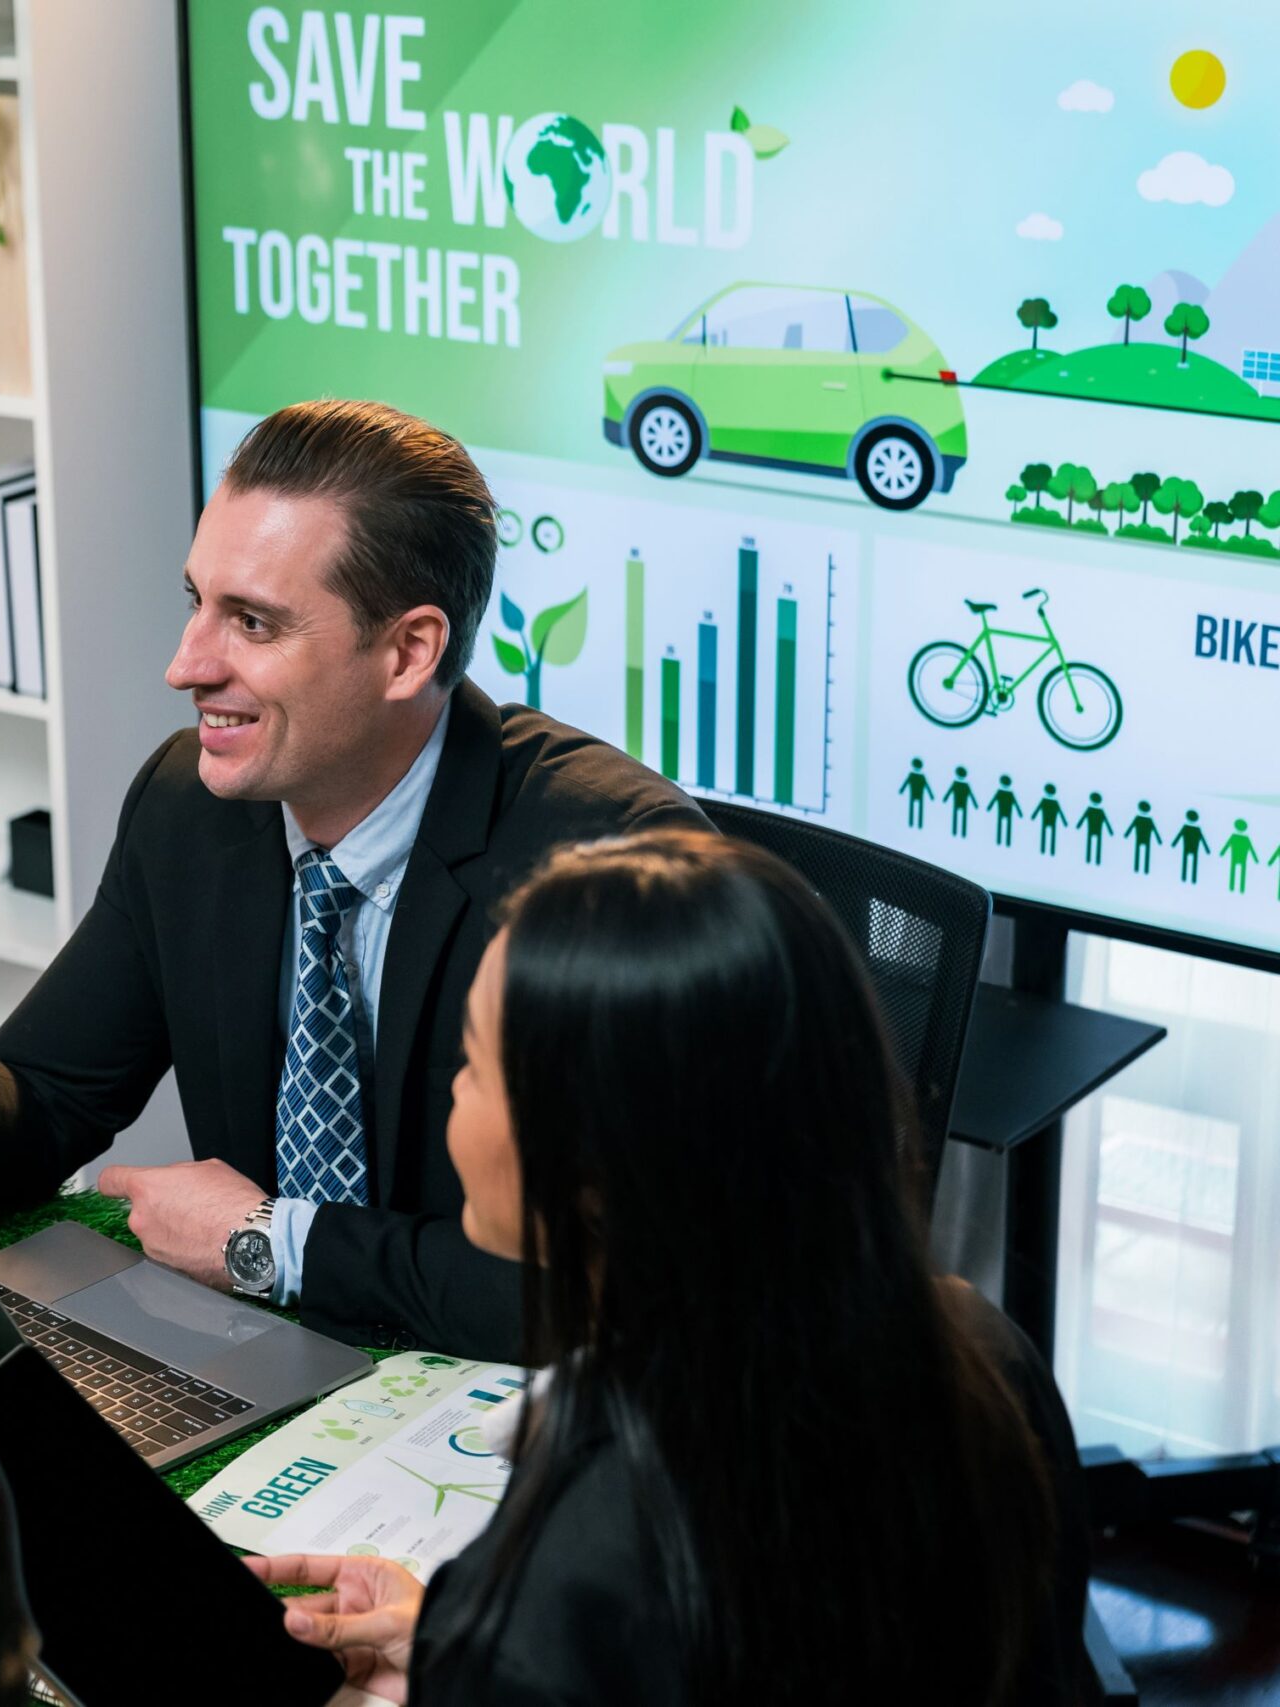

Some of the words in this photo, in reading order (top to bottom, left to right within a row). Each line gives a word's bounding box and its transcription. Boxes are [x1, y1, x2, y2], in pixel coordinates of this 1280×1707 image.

[247, 6, 427, 131] SAVE
[344, 147, 429, 221] THE
[222, 226, 521, 348] TOGETHER
[1195, 613, 1280, 670] BIKE
[241, 1456, 339, 1519] GREEN
